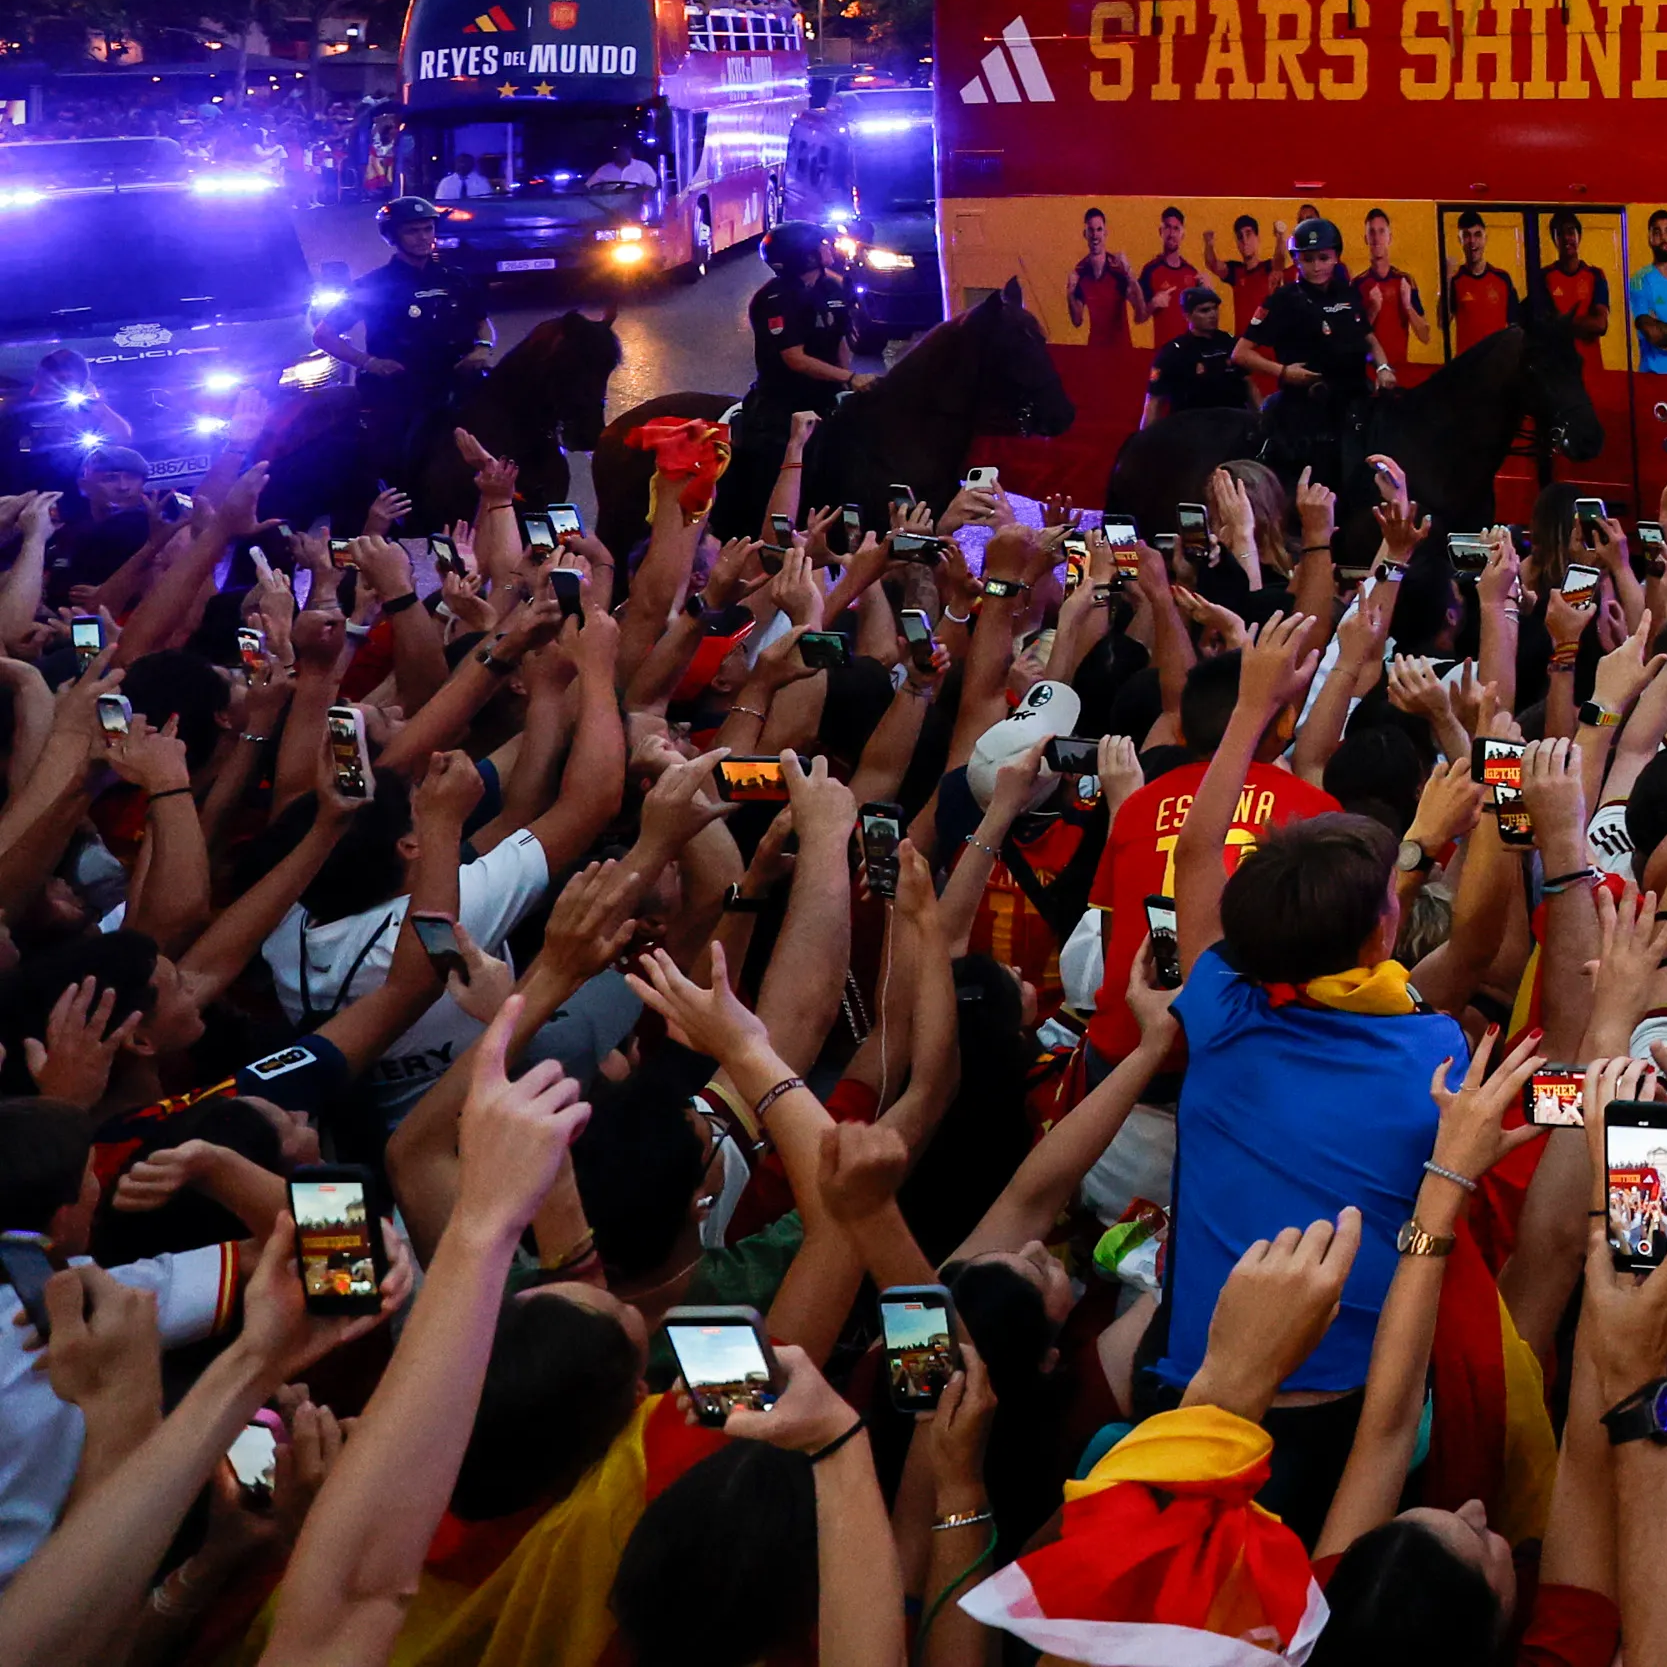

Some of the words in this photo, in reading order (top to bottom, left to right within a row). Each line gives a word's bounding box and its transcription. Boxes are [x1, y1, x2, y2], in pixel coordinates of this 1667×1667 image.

[419, 45, 500, 81] REYES
[503, 50, 527, 66] DEL
[528, 43, 637, 76] MUNDO
[1156, 784, 1276, 832] ESÑA
